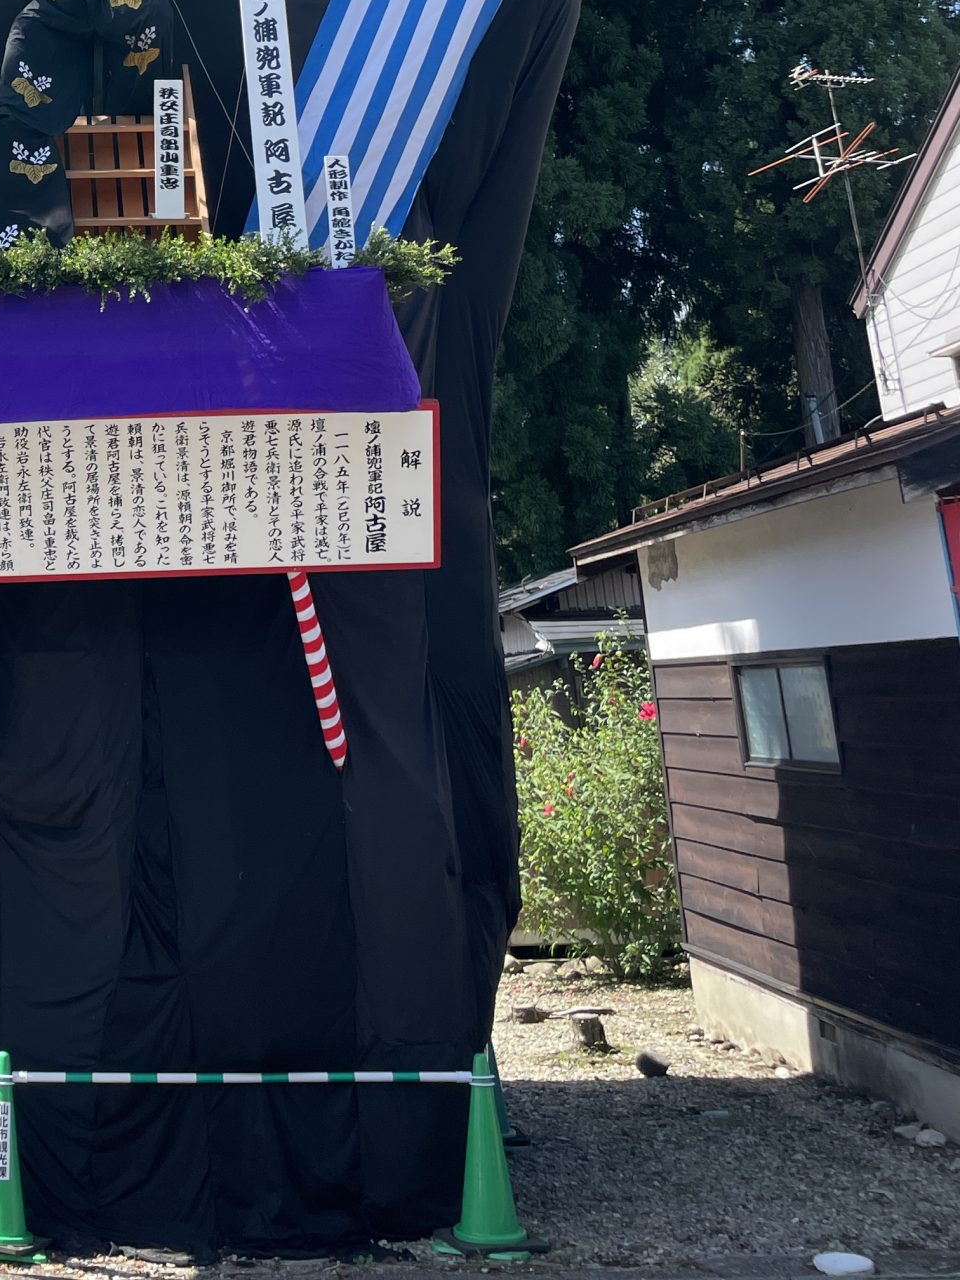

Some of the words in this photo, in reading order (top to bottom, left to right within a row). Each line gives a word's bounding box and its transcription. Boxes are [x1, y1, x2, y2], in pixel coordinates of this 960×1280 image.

[264, 137, 297, 231] 阿古屋
[287, 418, 306, 562] 源氏に追われる平家武将
[400, 448, 422, 517] 解説
